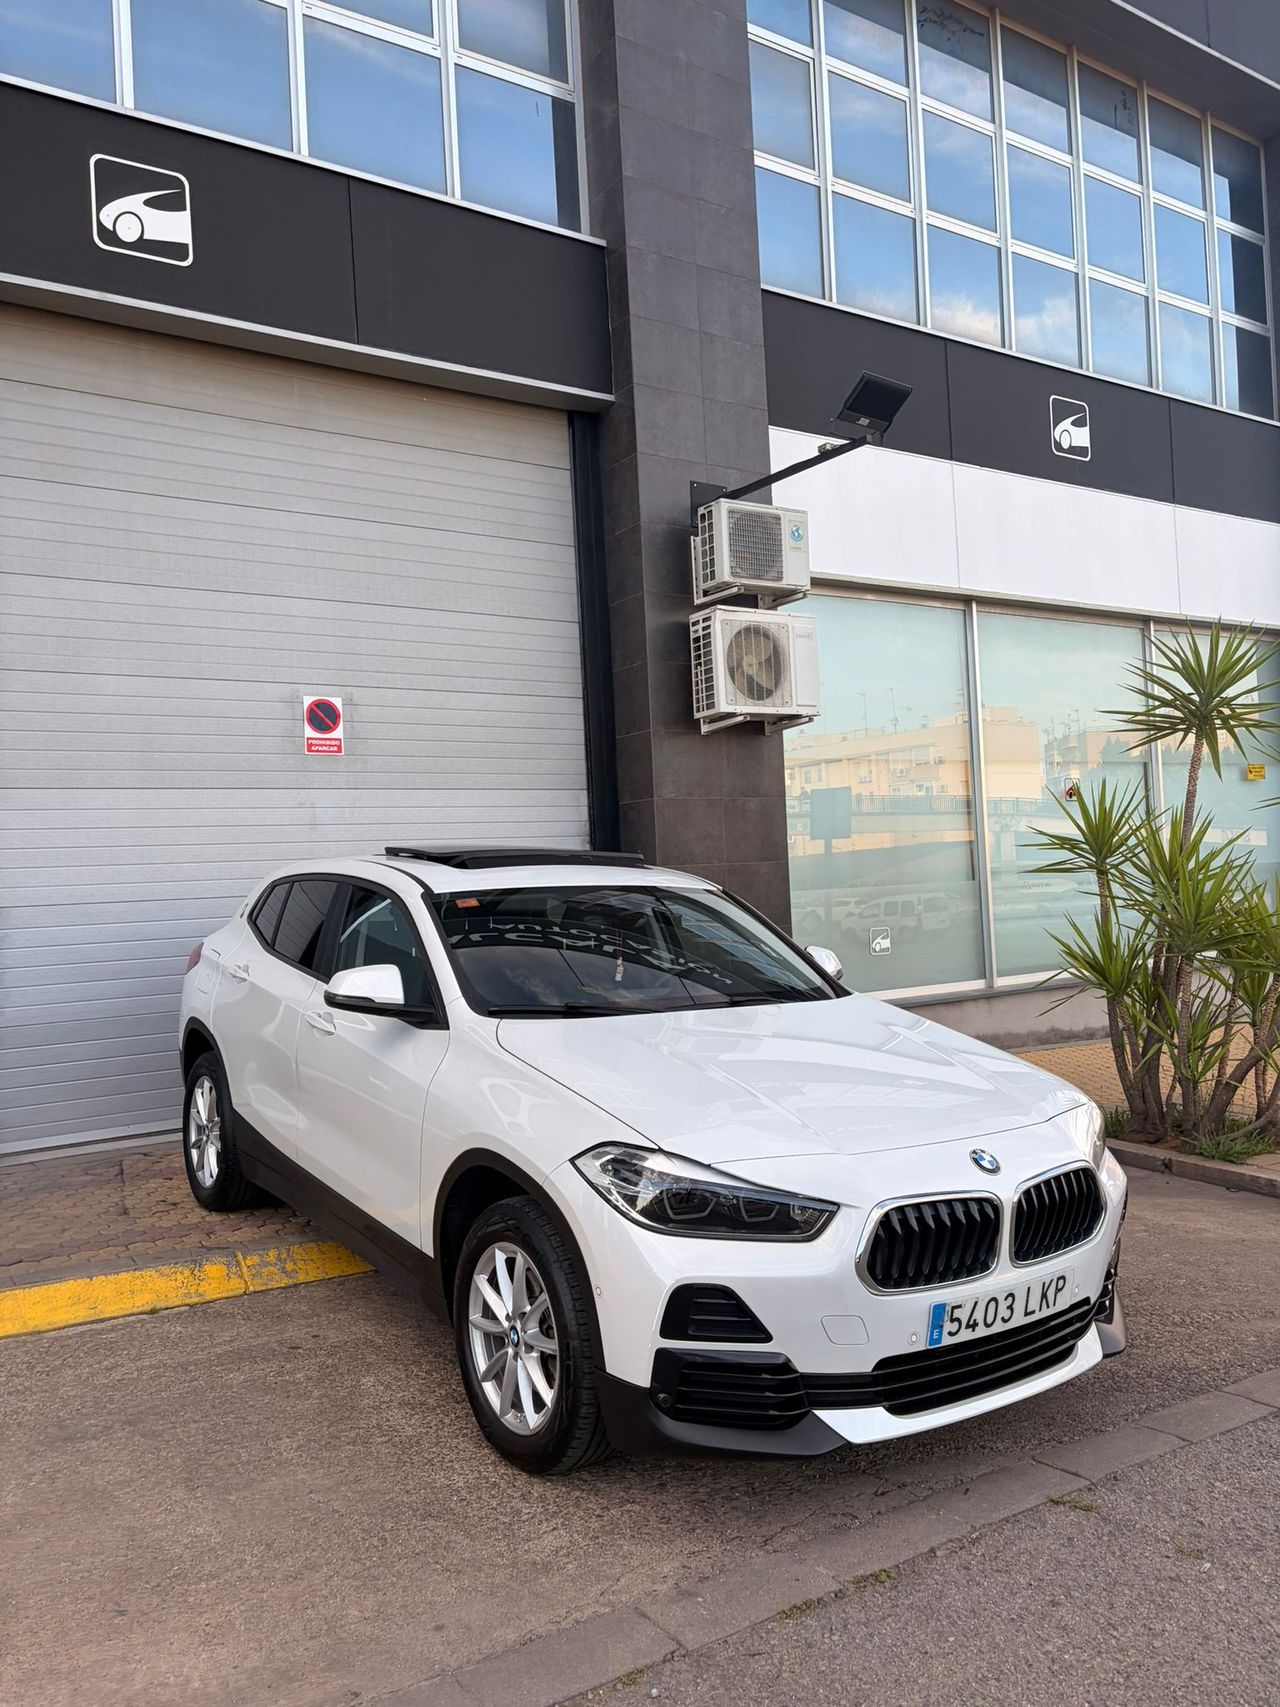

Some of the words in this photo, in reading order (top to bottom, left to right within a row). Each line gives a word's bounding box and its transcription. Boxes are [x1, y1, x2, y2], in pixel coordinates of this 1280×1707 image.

[947, 1292, 1016, 1337] 5403
[1024, 1275, 1067, 1318] LKP
[933, 1329, 940, 1340] E
